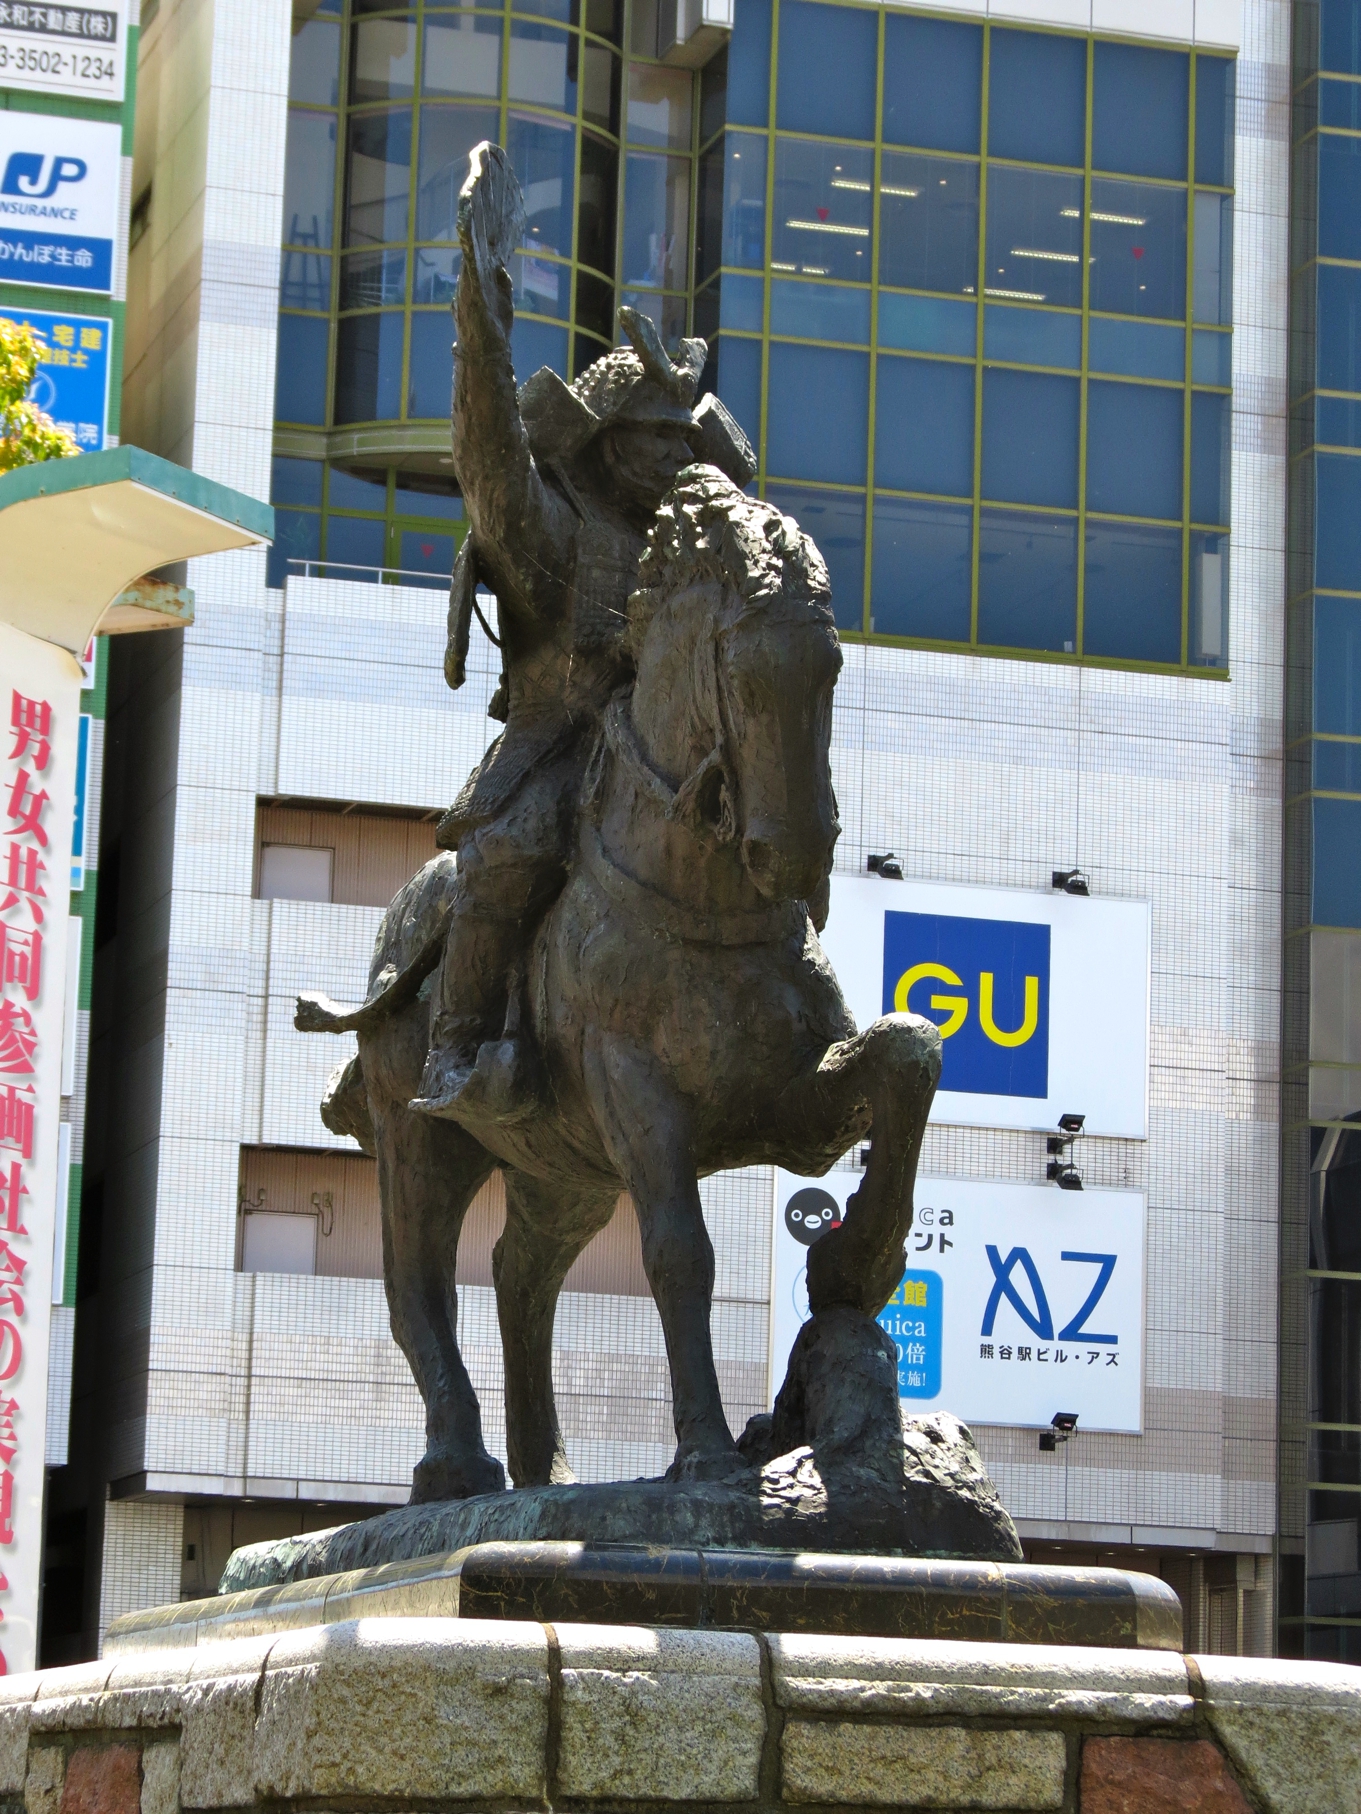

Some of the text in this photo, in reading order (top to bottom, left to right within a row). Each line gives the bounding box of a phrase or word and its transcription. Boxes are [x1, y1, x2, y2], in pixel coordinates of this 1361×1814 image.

[1, 151, 87, 198] JP
[894, 963, 1039, 1047] GU
[979, 1343, 1120, 1367] 熊谷駅ビル・アズ
